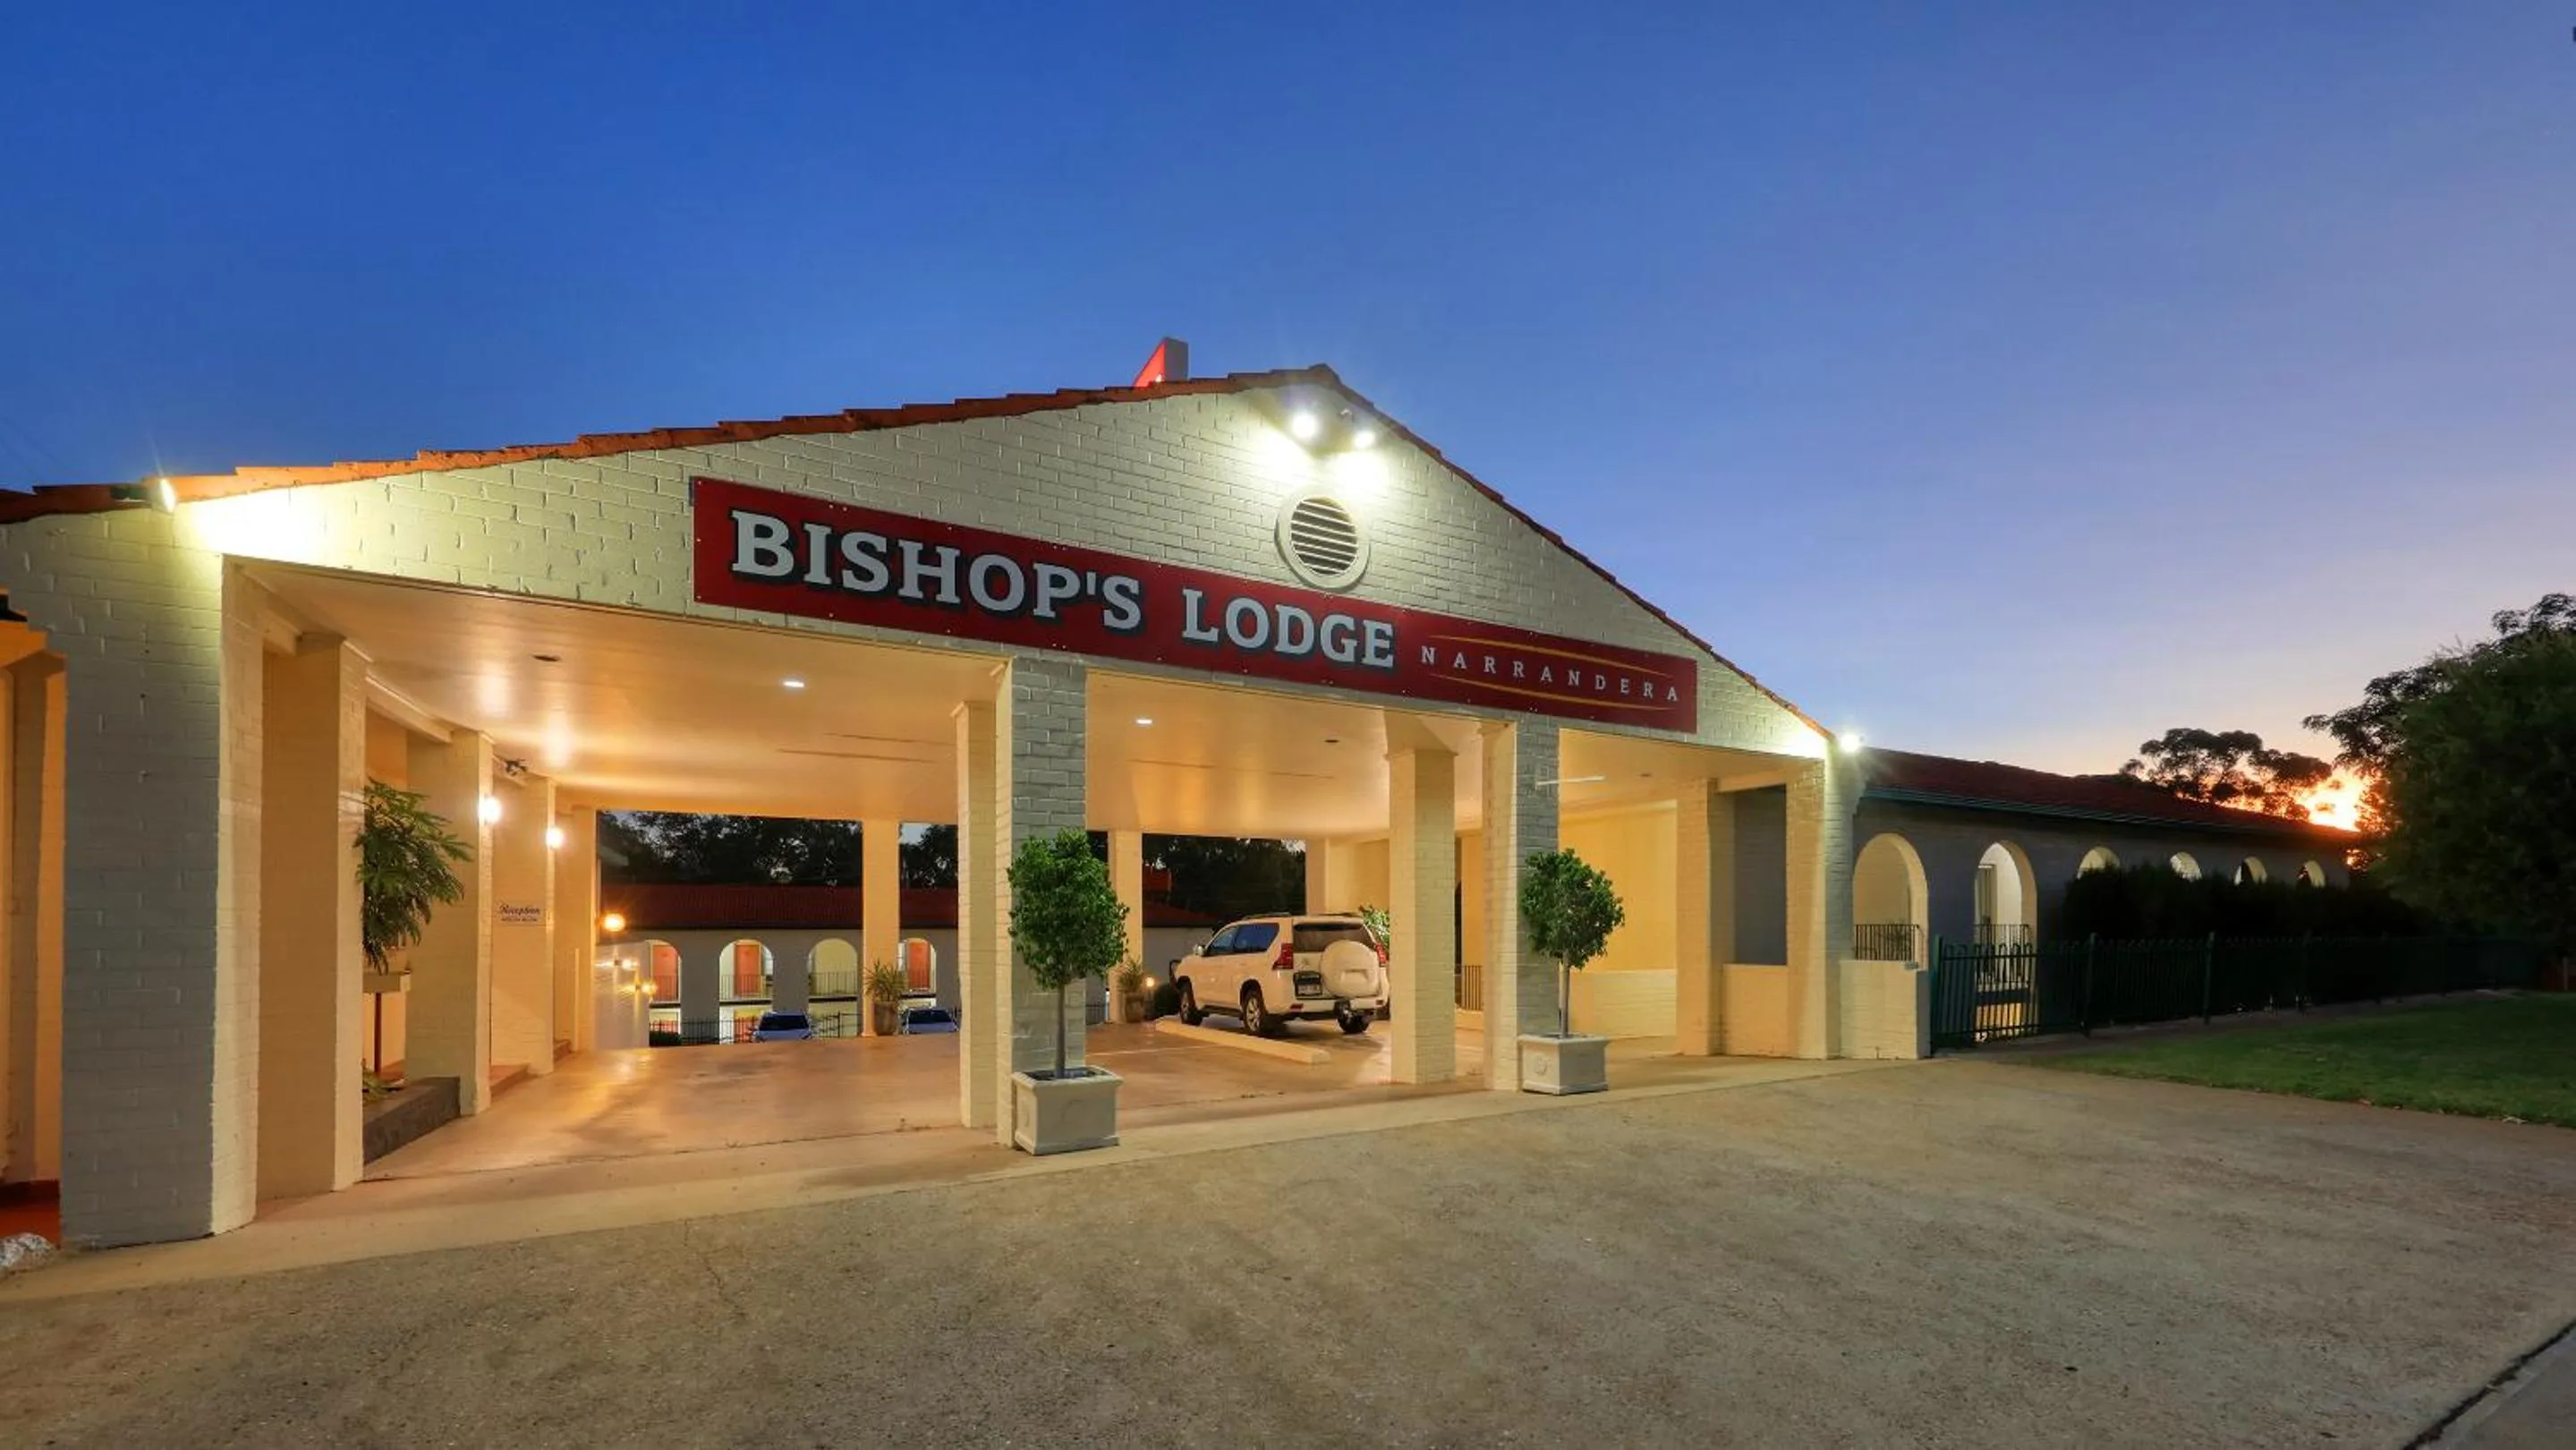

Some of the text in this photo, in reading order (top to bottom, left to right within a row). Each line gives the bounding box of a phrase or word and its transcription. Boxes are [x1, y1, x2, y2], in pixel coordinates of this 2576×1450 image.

[730, 508, 1396, 668] BISHOP'S LODGE
[1420, 644, 1679, 703] NARRANDERA
